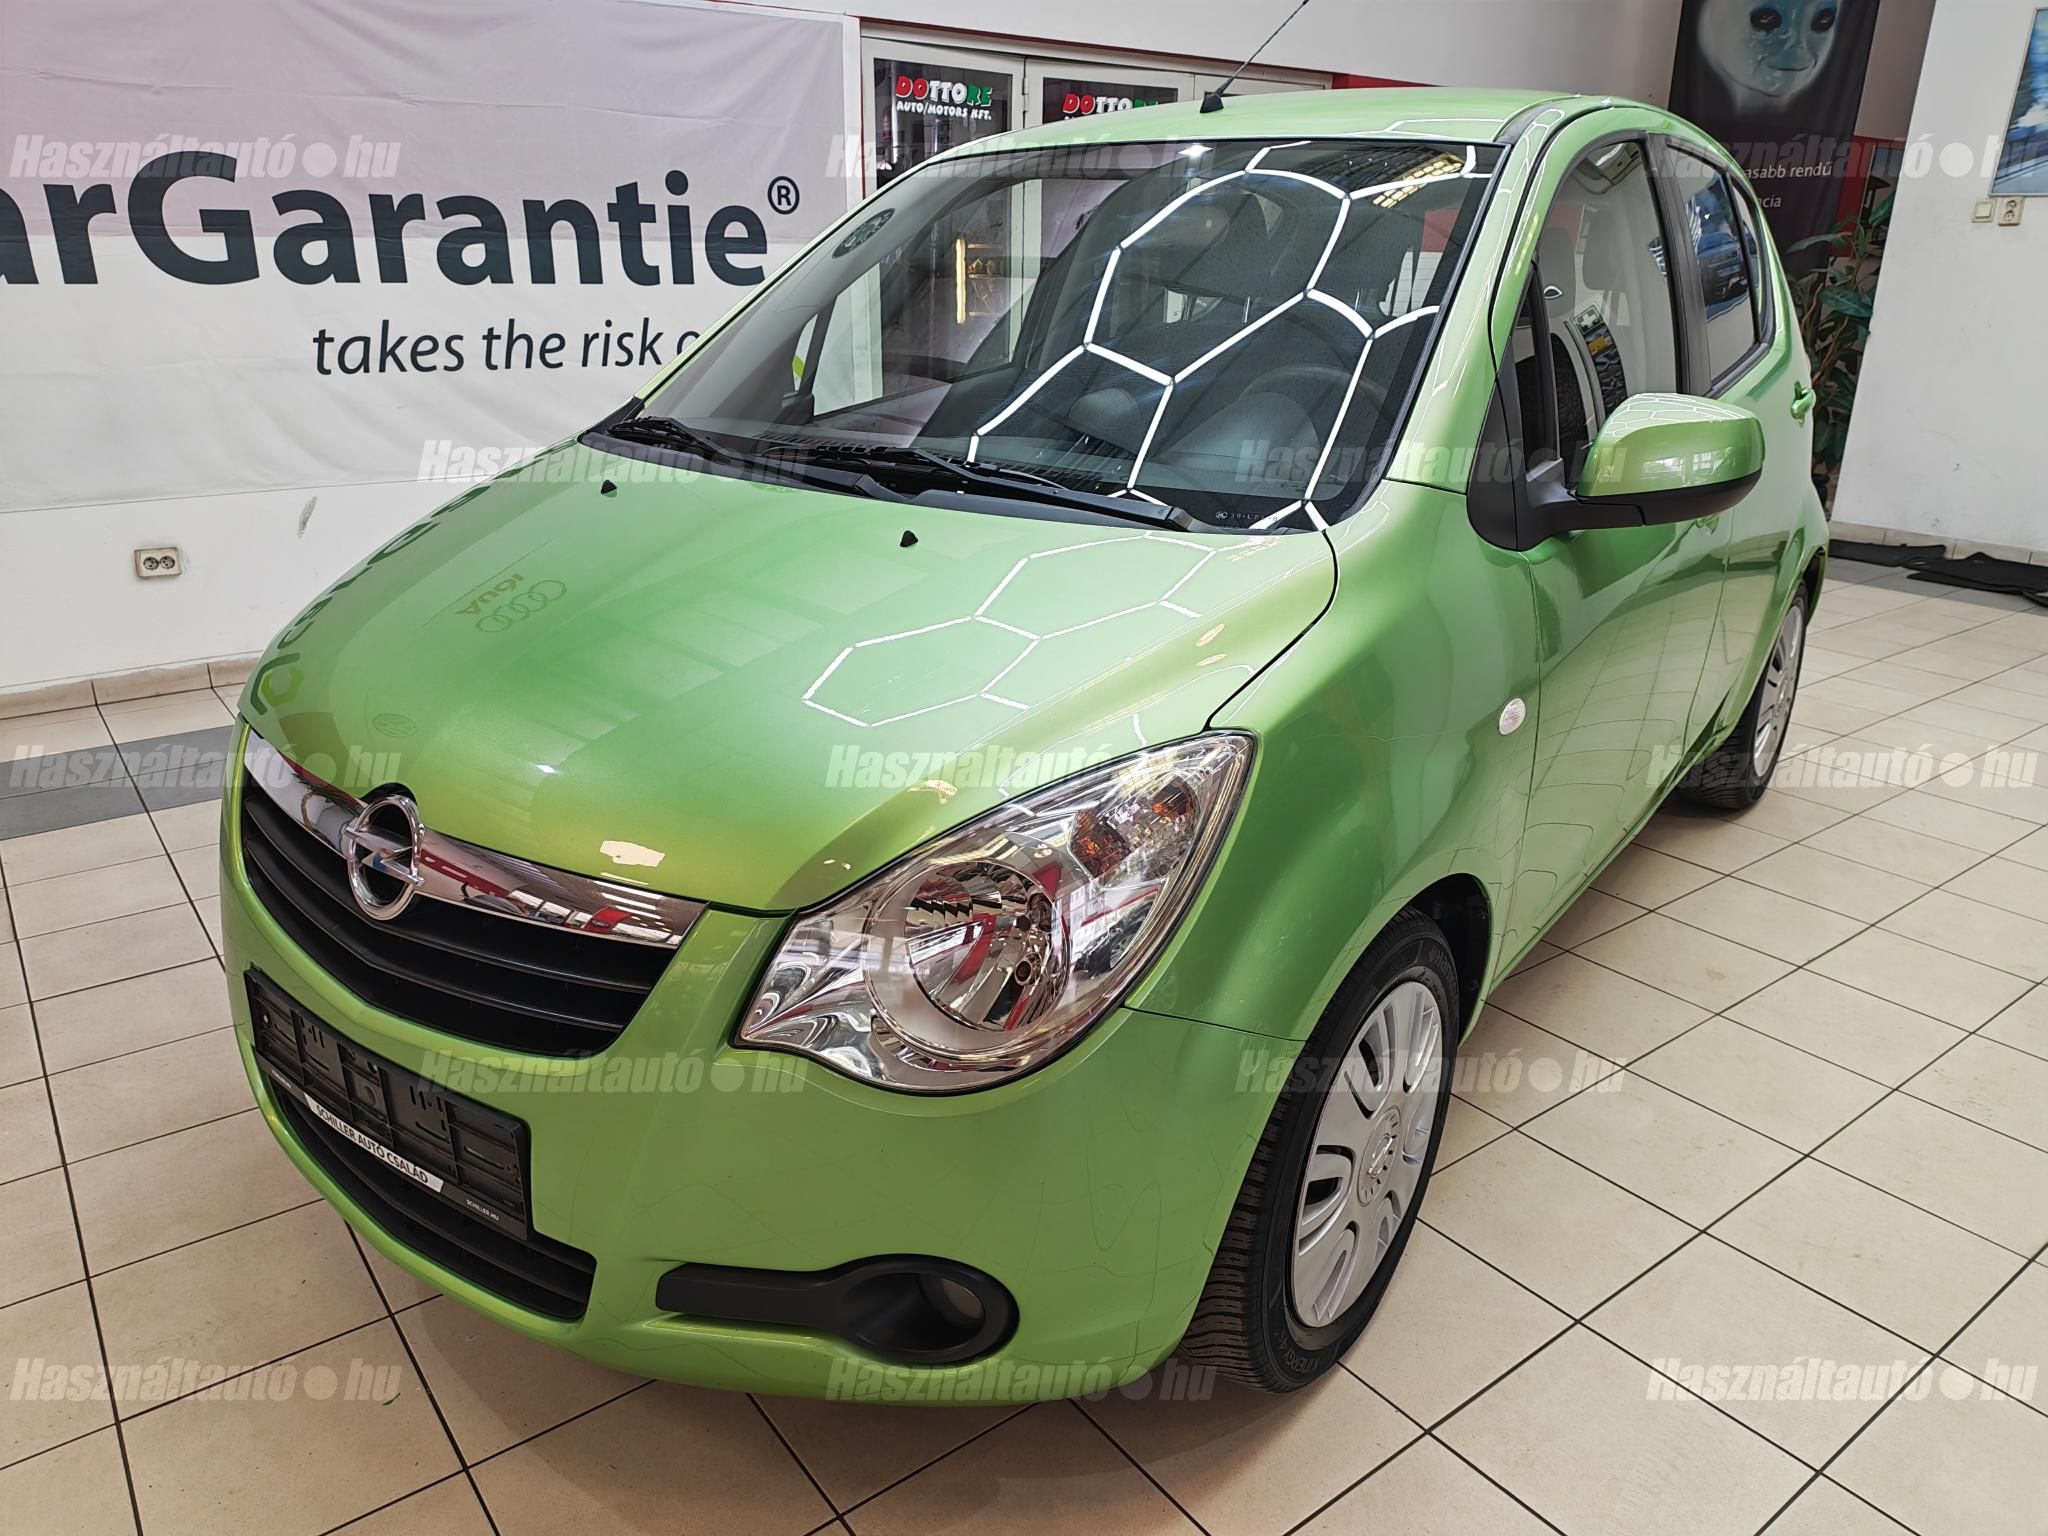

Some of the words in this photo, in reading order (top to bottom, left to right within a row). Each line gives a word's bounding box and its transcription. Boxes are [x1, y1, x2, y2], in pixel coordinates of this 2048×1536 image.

[895, 75, 993, 107] DOTTORE
[896, 100, 968, 119] AUTO/MOTORS
[312, 319, 465, 376] takes
[482, 318, 566, 371] the
[581, 317, 665, 368] risk
[316, 1105, 357, 1141] SCHILLER
